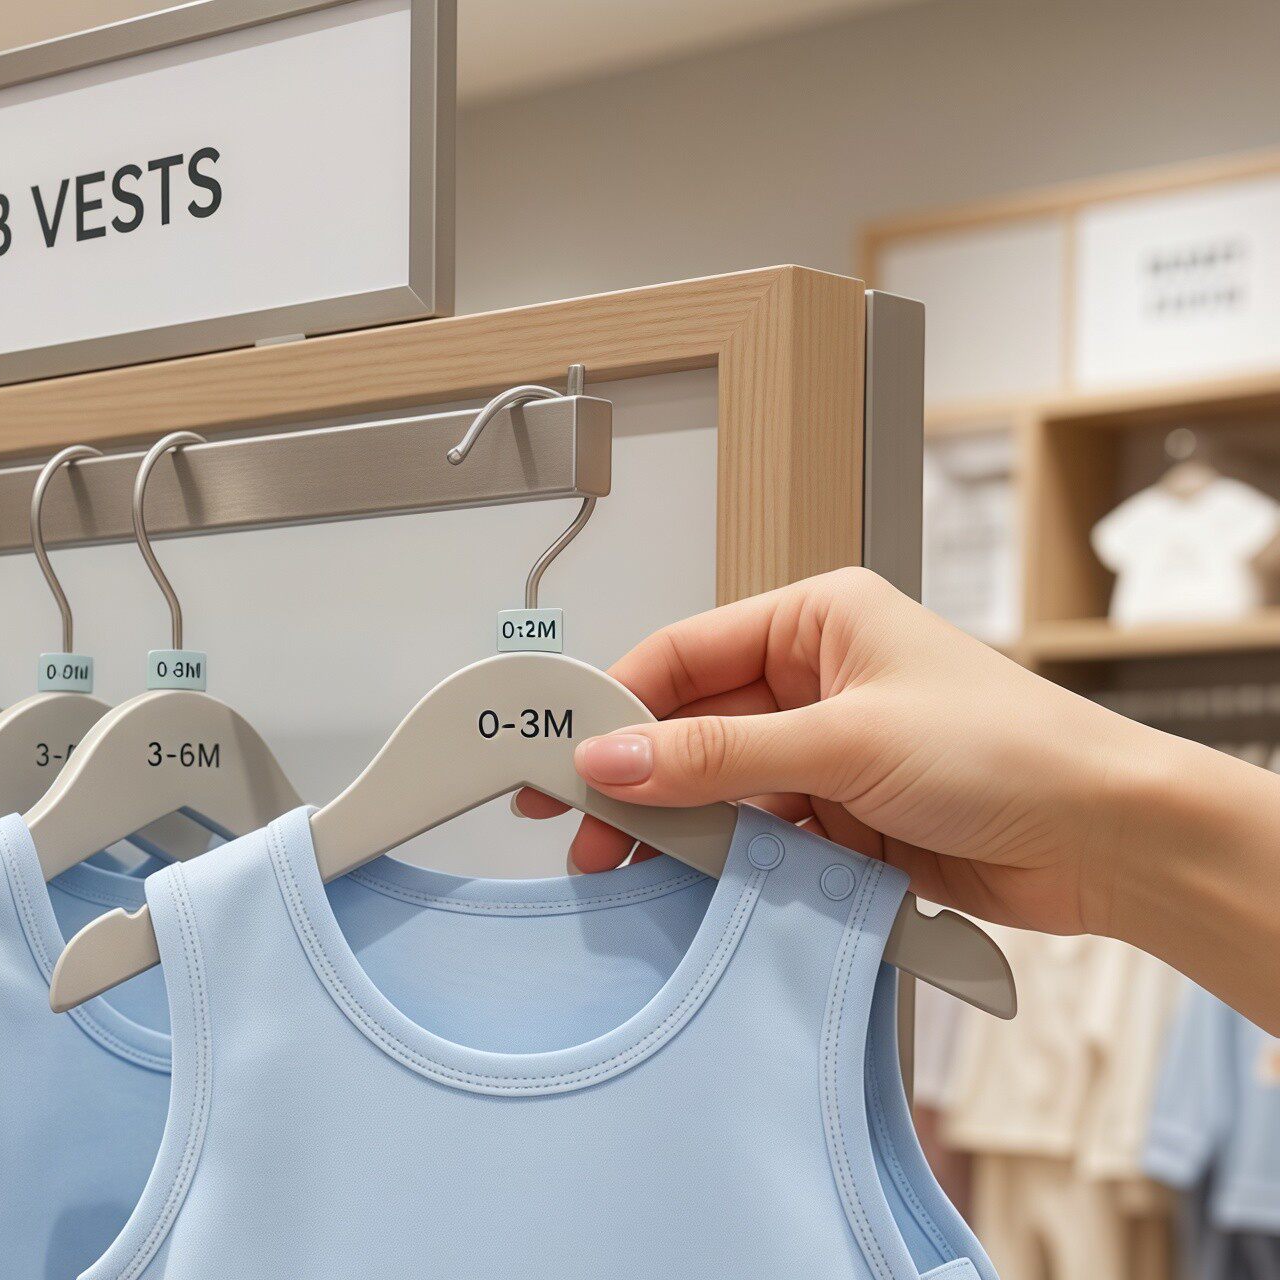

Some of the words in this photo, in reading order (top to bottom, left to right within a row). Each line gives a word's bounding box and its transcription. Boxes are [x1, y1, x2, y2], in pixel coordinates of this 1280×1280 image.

[31, 146, 224, 249] VESTS
[478, 708, 573, 739] 0-3M
[147, 741, 221, 768] 3-6M
